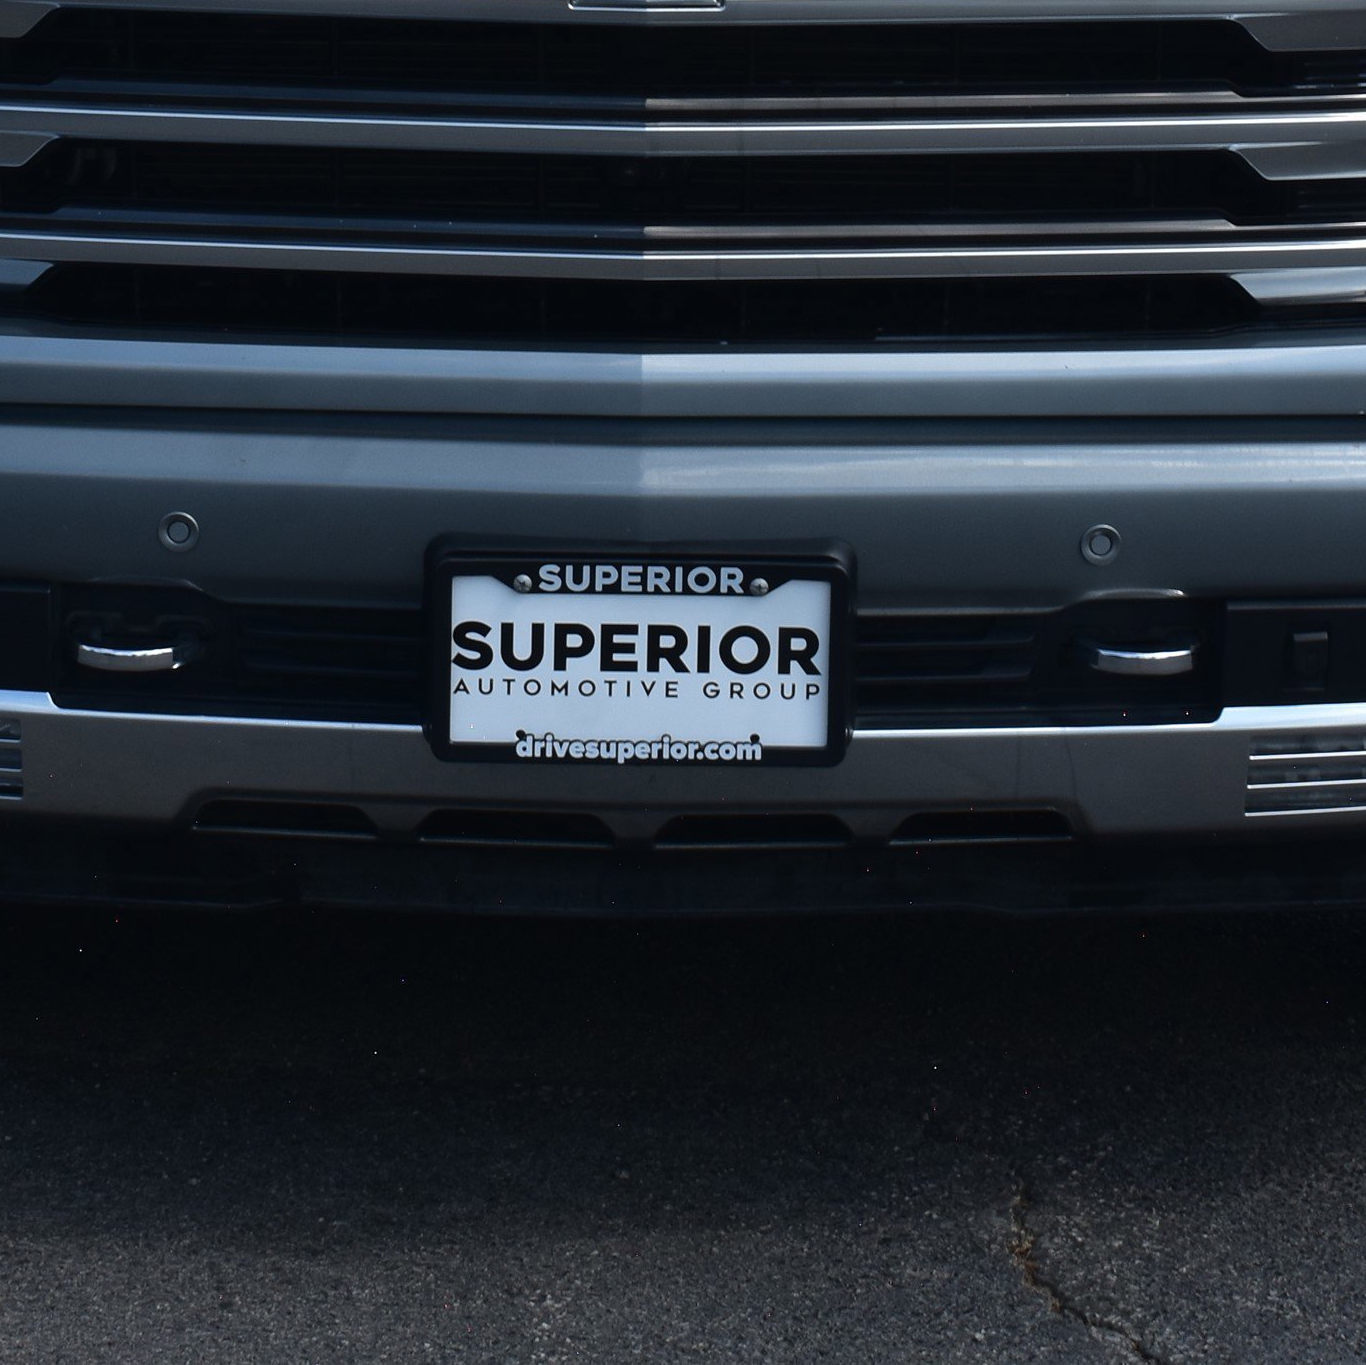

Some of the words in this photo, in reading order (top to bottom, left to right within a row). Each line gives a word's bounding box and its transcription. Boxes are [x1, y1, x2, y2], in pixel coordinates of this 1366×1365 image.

[537, 563, 744, 595] SUPERIOR
[450, 620, 821, 676] SUPERIOR
[453, 677, 679, 699] AUTOMOTIVE
[702, 681, 820, 701] GROUP
[515, 734, 762, 763] drivesuperior.com
